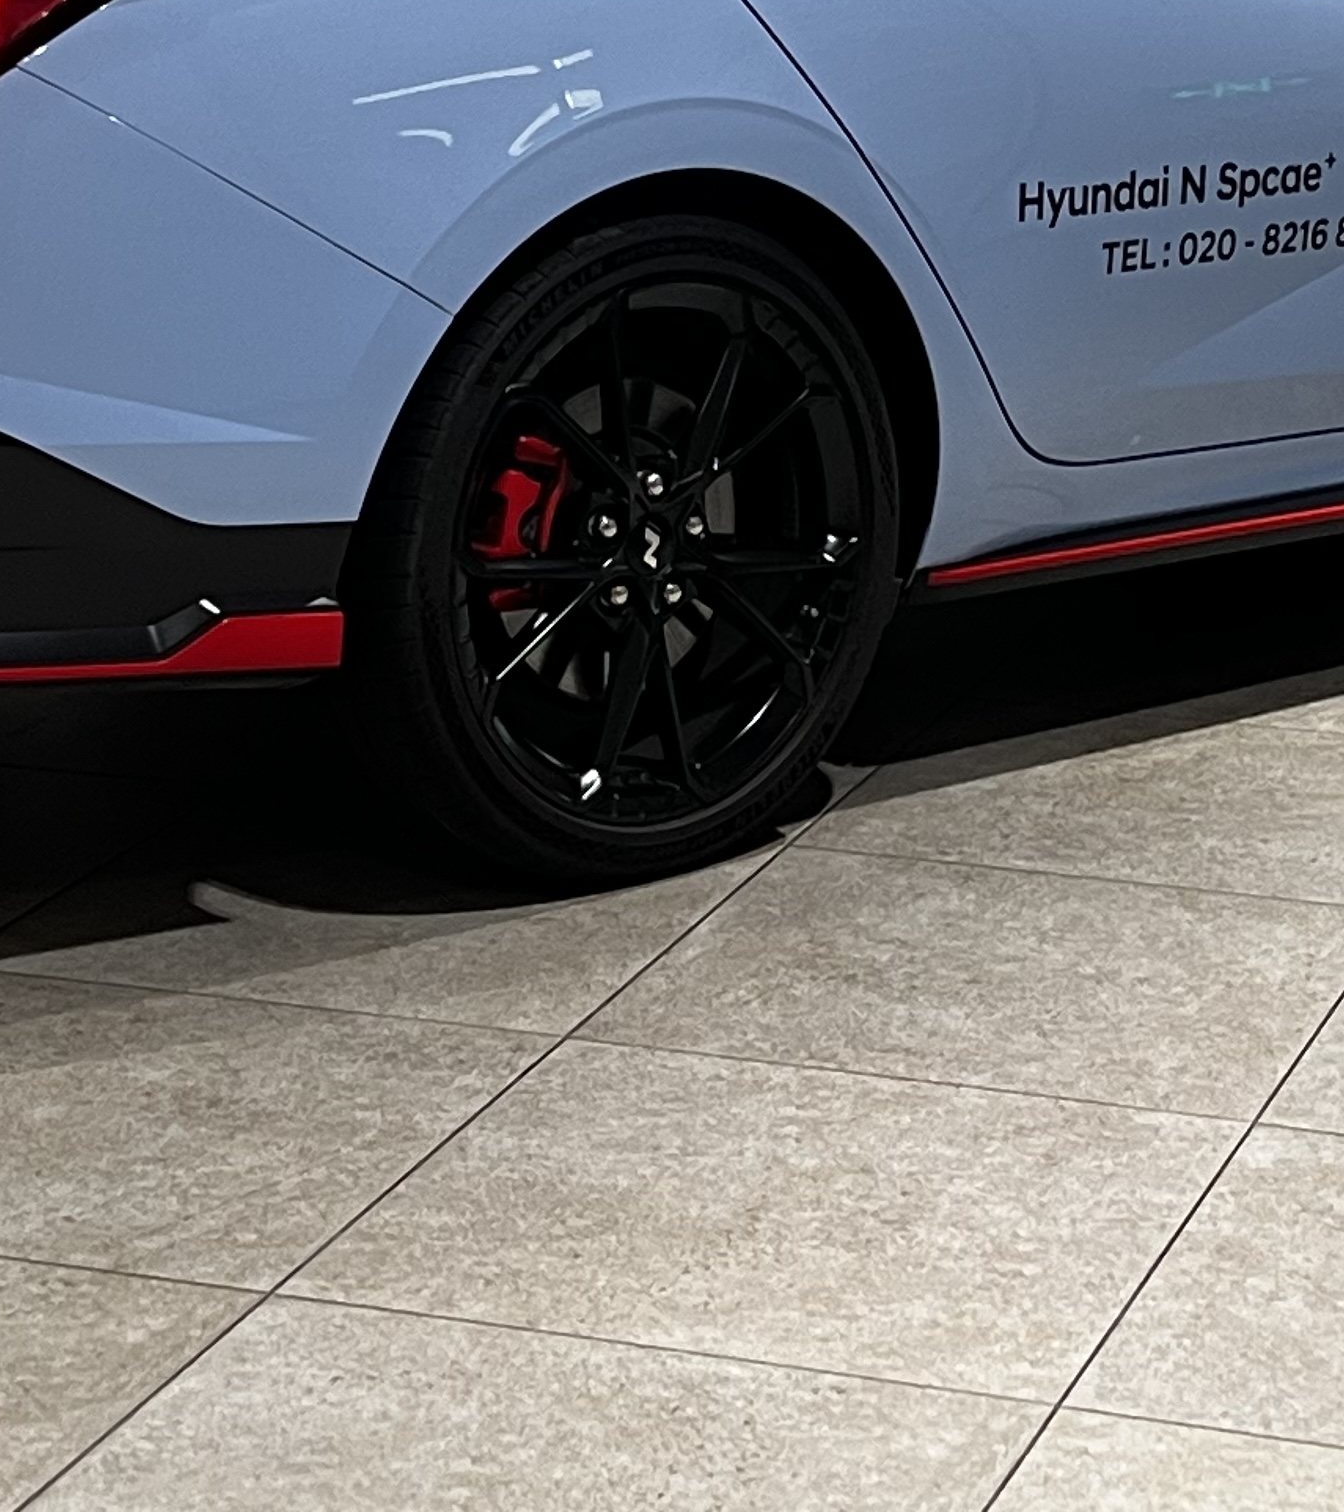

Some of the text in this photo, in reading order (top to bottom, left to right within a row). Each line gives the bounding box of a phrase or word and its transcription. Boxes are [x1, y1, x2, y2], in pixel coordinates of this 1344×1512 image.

[1018, 165, 1170, 228] Hyundai
[1180, 165, 1207, 205] N
[1178, 228, 1237, 266] 020
[1262, 218, 1329, 256] 8216
